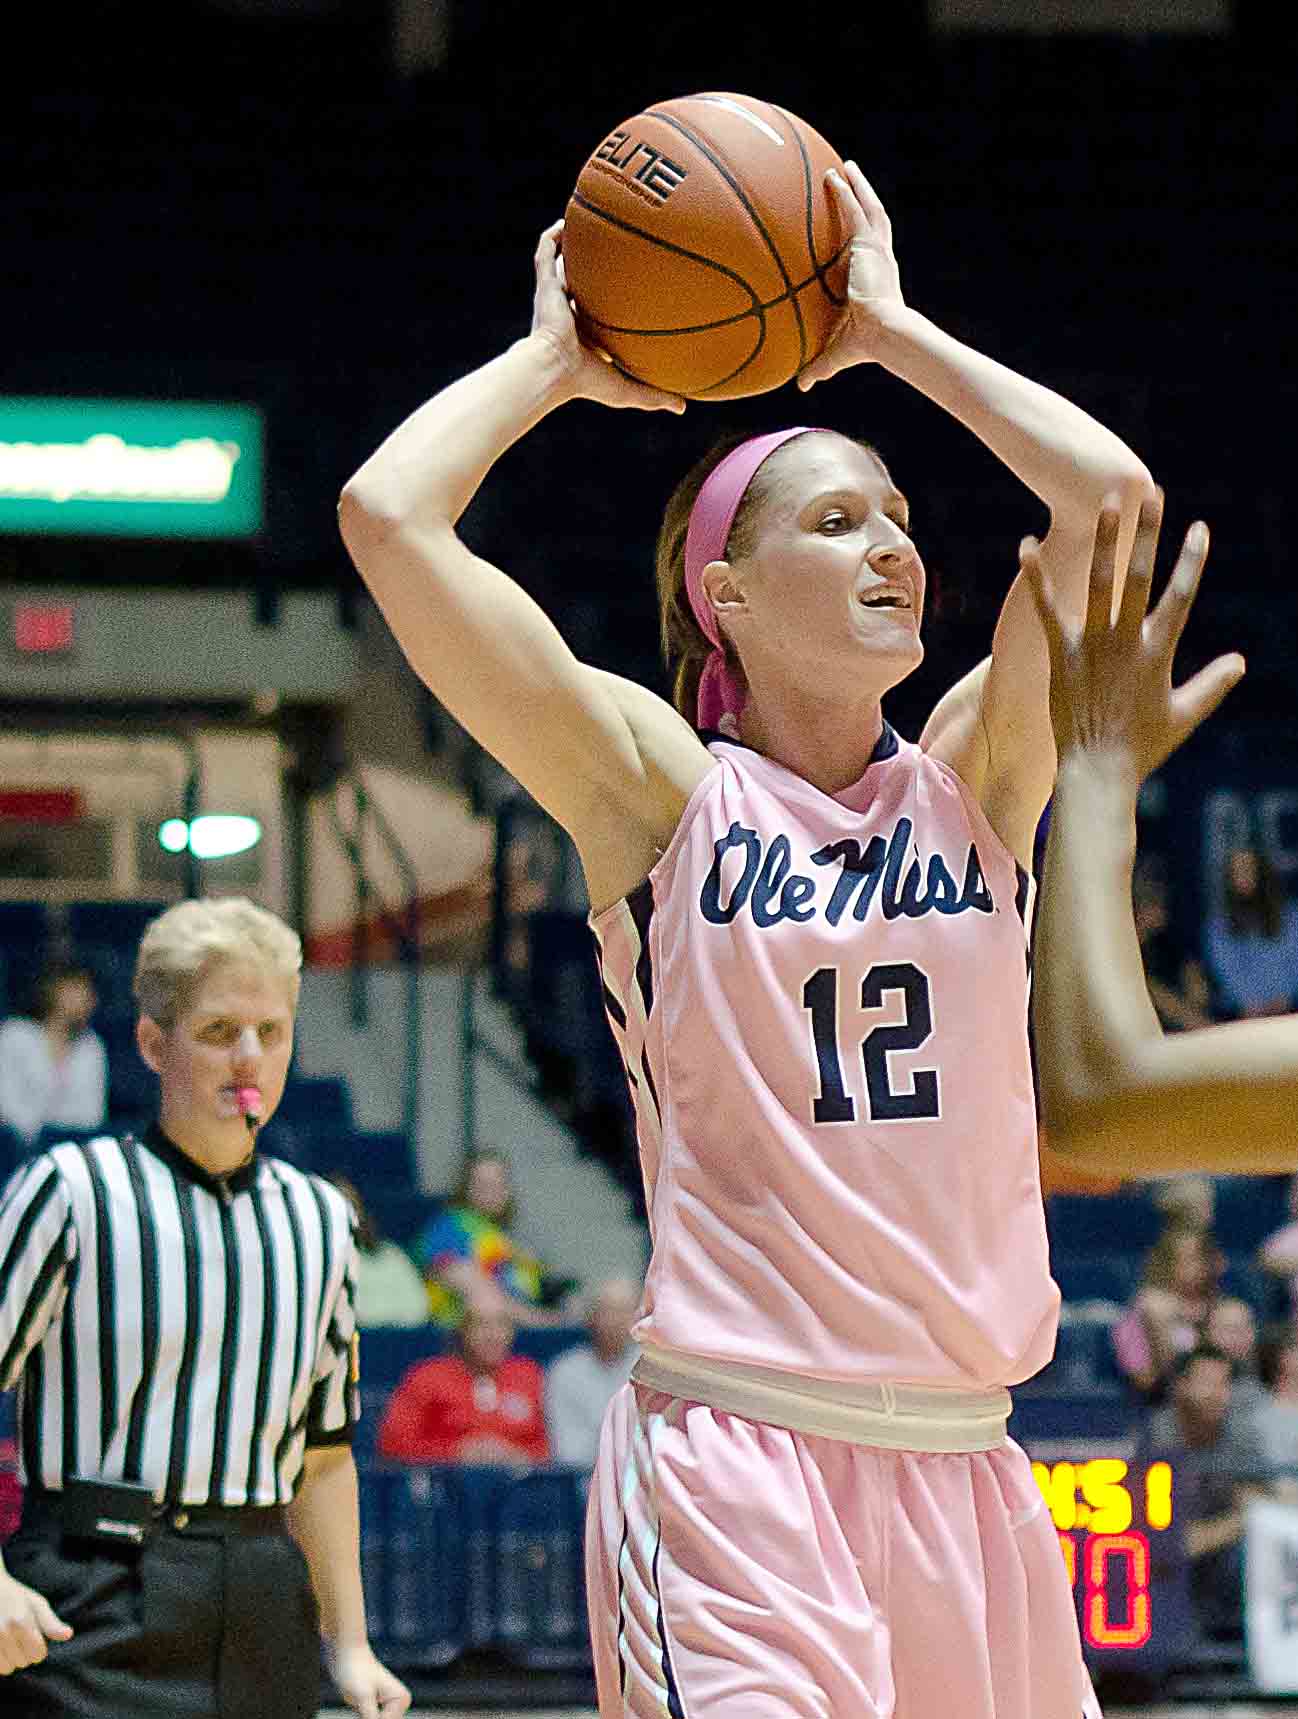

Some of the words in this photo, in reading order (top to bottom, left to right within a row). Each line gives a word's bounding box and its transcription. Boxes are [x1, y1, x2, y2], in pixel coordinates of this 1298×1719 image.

[593, 129, 689, 202] ELITE
[699, 820, 817, 929] Ole
[810, 816, 998, 928] Miss
[802, 961, 941, 1124] 12
[1058, 1531, 1152, 1649] 0
